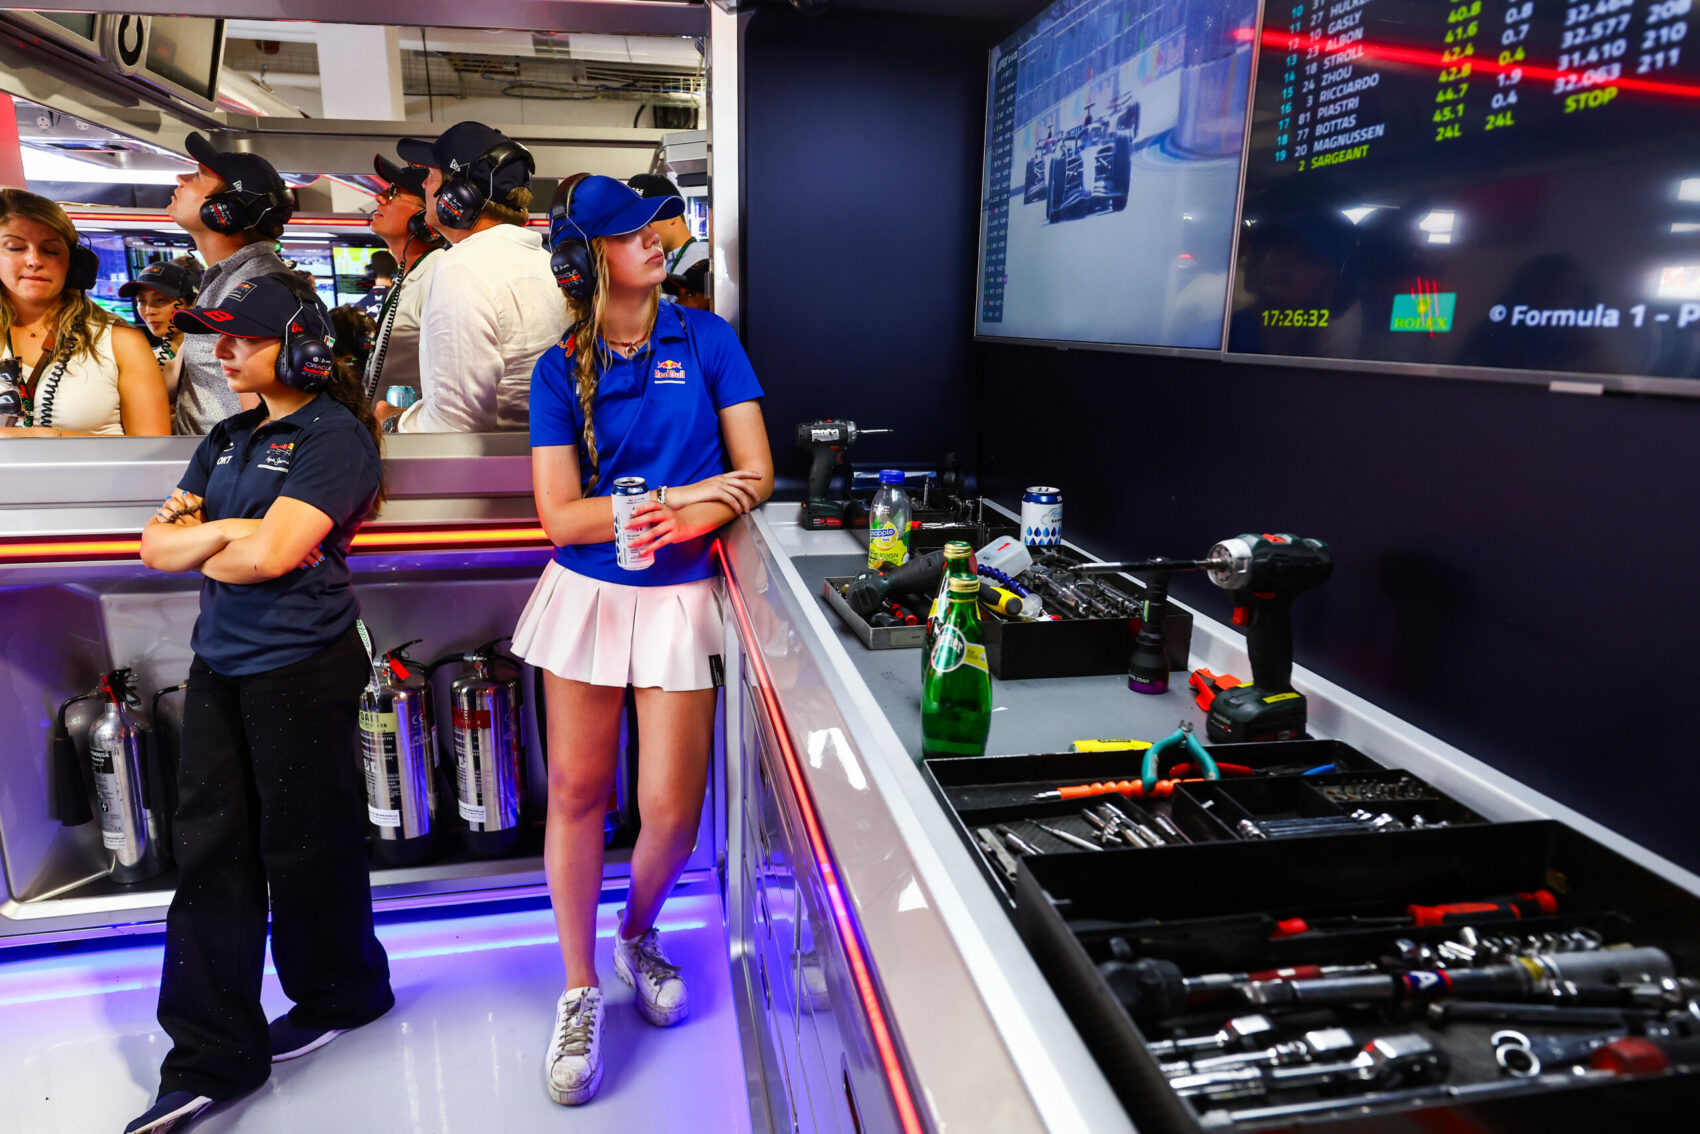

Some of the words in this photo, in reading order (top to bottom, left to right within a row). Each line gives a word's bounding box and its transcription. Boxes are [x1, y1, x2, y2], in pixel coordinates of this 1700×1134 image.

[1288, 38, 1299, 51] 12
[1309, 28, 1322, 42] 10
[1327, 10, 1362, 35] GASLY
[1289, 21, 1301, 34] 11
[1310, 11, 1324, 26] 27
[1292, 4, 1304, 18] 10
[1282, 86, 1294, 99] 15
[1303, 79, 1315, 93] 24
[1321, 65, 1353, 87] ZHOU
[1444, 20, 1479, 43] 41.6
[1504, 1, 1534, 24] 0.8
[1284, 70, 1296, 83] 14
[1305, 62, 1318, 75] 18
[1323, 45, 1364, 70] STROLL
[1447, 1, 1482, 23] 40.8
[1286, 54, 1298, 67] 13
[1306, 45, 1319, 60] 23
[1325, 26, 1364, 52] ALBON
[1277, 134, 1288, 146] 18
[1297, 128, 1310, 141] 77
[1315, 114, 1357, 137] BOTTAS
[1435, 82, 1469, 103] 44.7
[1495, 68, 1522, 88] 1.9
[1557, 38, 1627, 72] 31.410
[1641, 21, 1688, 50] 210
[1279, 118, 1290, 131] 17
[1298, 112, 1311, 125] 81
[1317, 96, 1360, 119] PIASTRI
[1438, 62, 1472, 83] 42.8
[1498, 45, 1525, 66] 0.4
[1560, 13, 1632, 49] 32.577
[1280, 102, 1292, 114] 16
[1306, 95, 1314, 107] 3
[1319, 72, 1380, 103] RICCIARDO
[1442, 42, 1474, 63] 42.4
[1501, 23, 1530, 46] 0.7
[1275, 149, 1287, 162] 19
[1294, 144, 1308, 157] 20
[1313, 123, 1385, 152] MAGNUSSEN
[1432, 103, 1465, 122] 45.1
[1491, 89, 1518, 109] 0.4
[1553, 62, 1622, 95] 32.063
[1636, 46, 1680, 75] 211
[1298, 160, 1305, 172] 2
[1311, 144, 1370, 169] SARGEANT
[1435, 123, 1462, 142] 24L
[1484, 110, 1515, 131] 24L
[1564, 86, 1619, 114] STOP
[1261, 309, 1330, 327] 17:26:32
[1394, 316, 1448, 329] ROLEX
[1510, 303, 1620, 328] Formula
[1629, 303, 1646, 328] 1
[1676, 303, 1700, 328] P
[654, 369, 670, 379] Red
[670, 369, 686, 379] Bull
